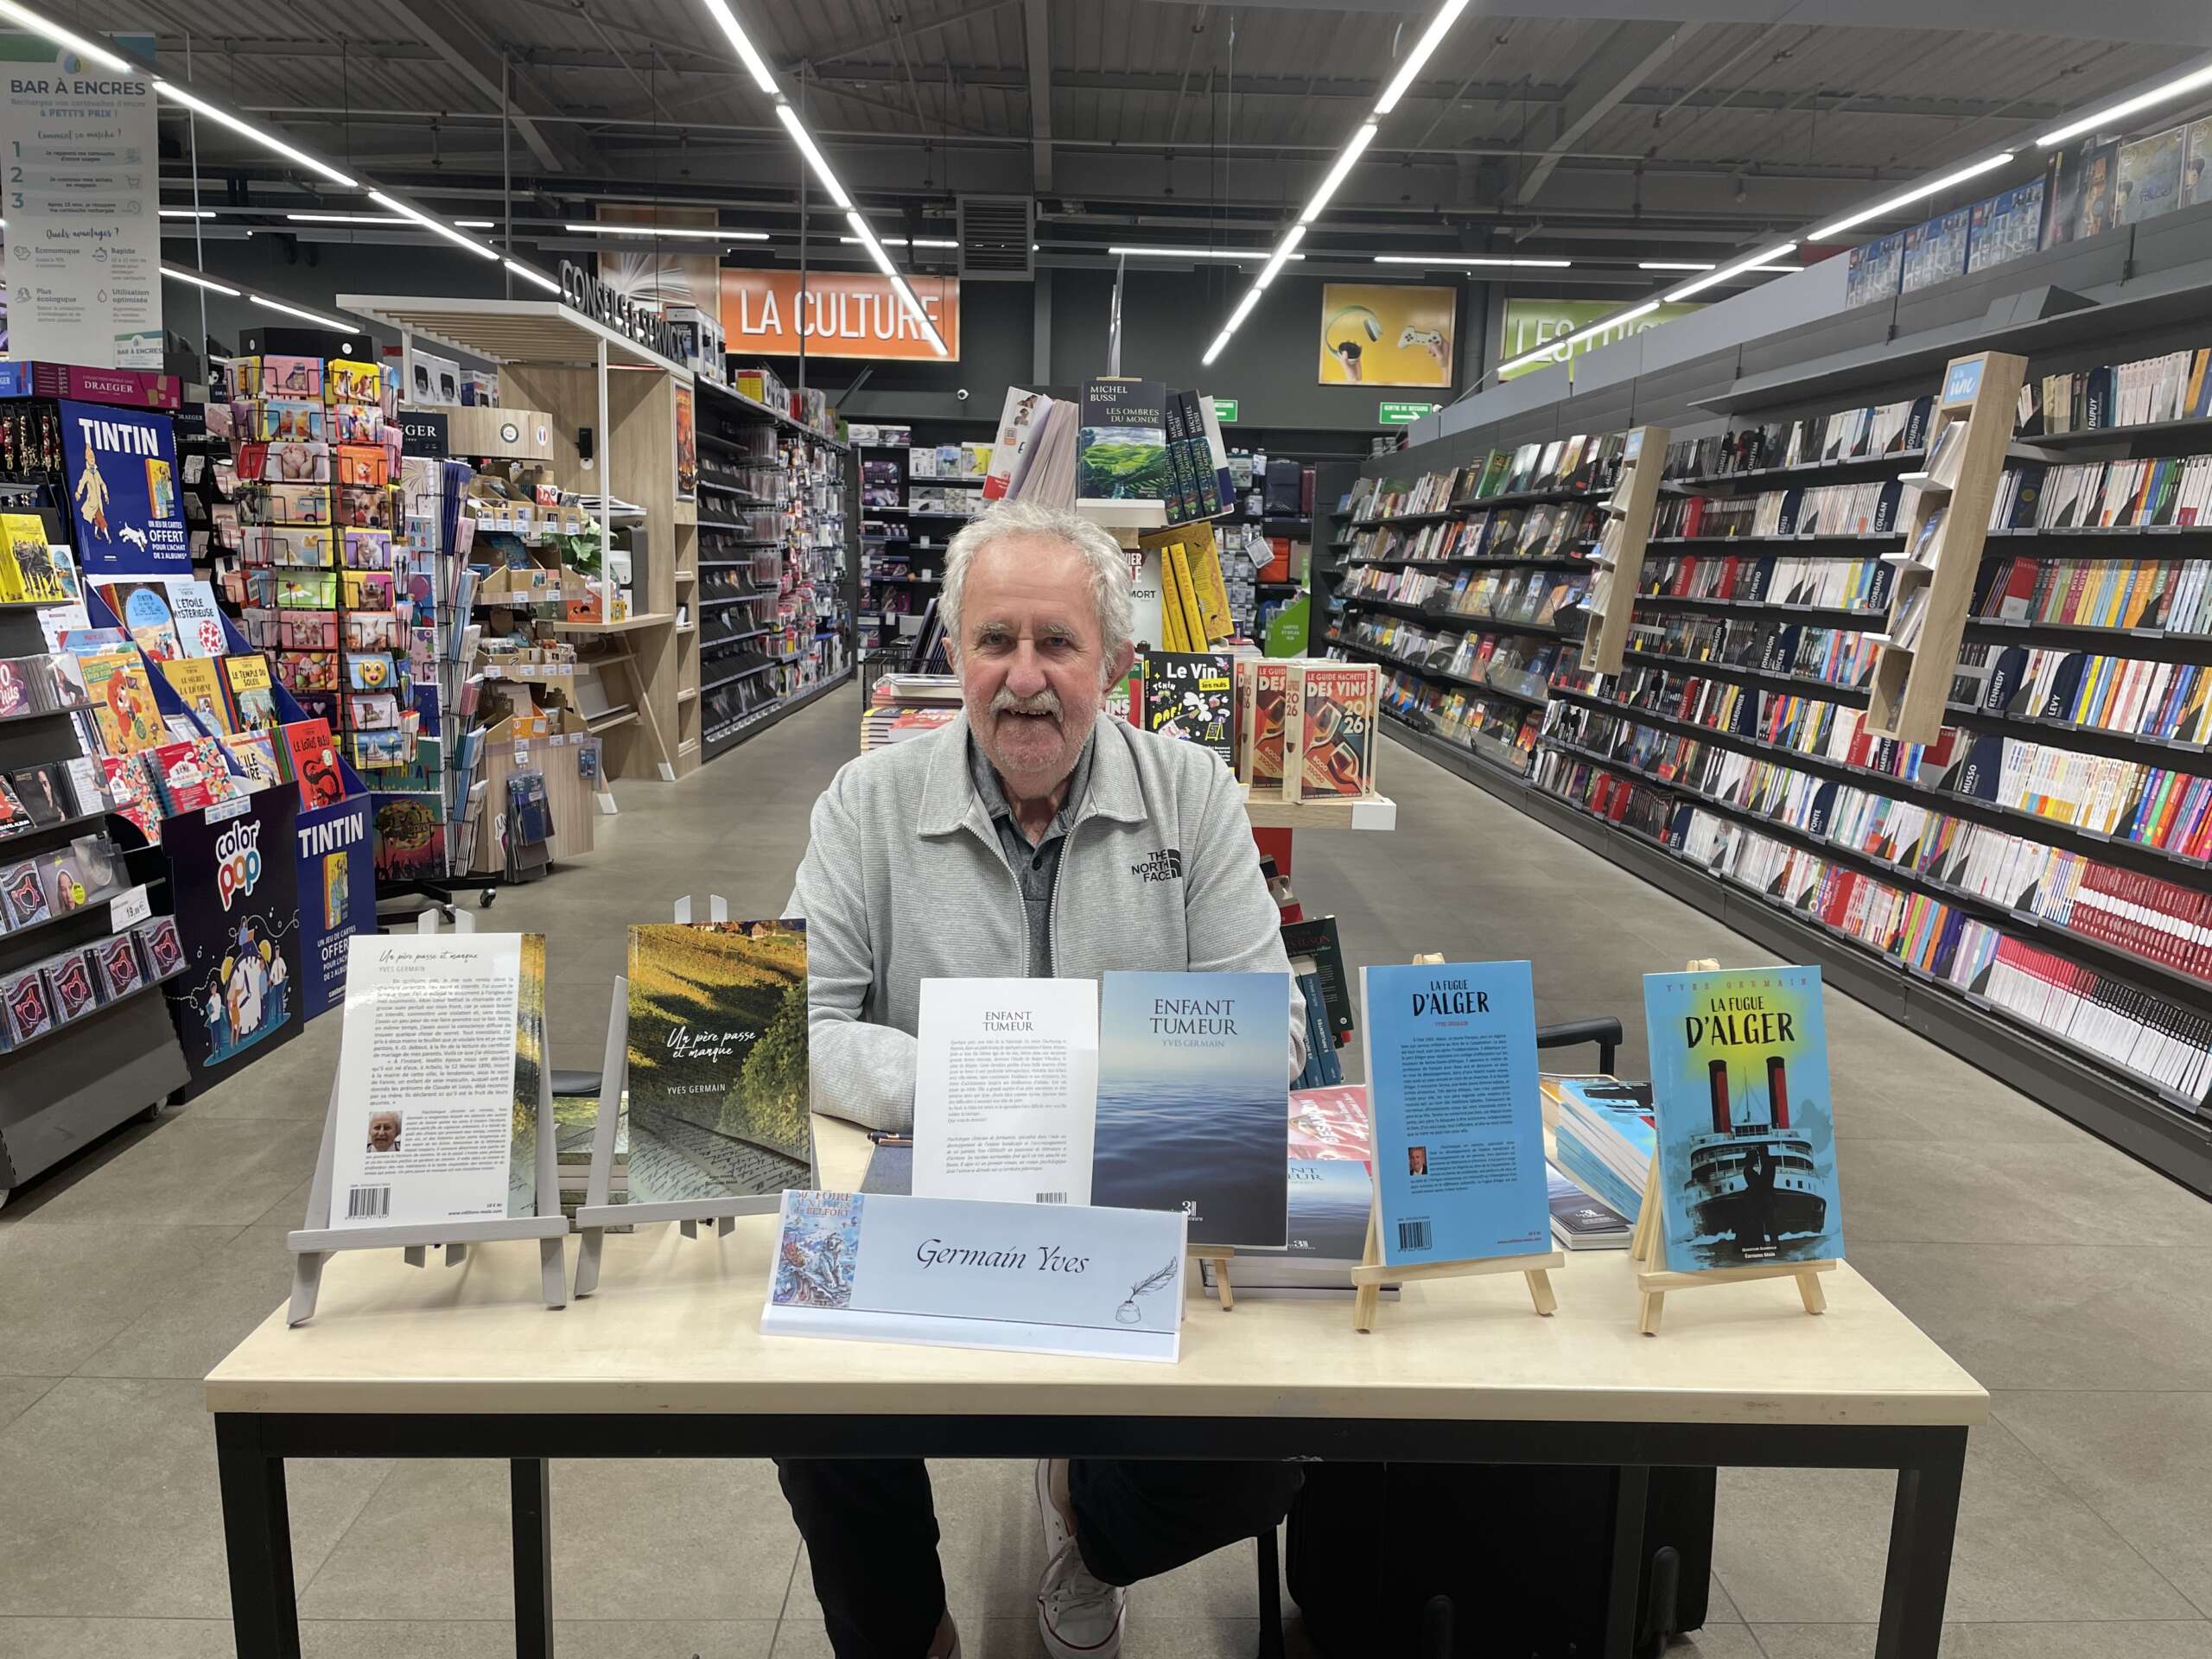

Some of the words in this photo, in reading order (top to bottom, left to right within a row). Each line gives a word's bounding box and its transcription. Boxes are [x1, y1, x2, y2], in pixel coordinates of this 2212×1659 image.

[10, 79, 49, 94] BAR
[54, 77, 68, 94] À
[73, 80, 146, 95] ENCRES
[49, 109, 85, 118] PETITS
[88, 109, 111, 118] PRIX
[12, 141, 21, 157] 1
[10, 167, 23, 182] 2
[11, 192, 24, 208] 3
[46, 228, 70, 238] Quels
[741, 289, 783, 335] LA
[84, 380, 134, 394] DRAEGER
[1090, 385, 1128, 394] MICHEL
[1090, 394, 1116, 403] BUSSI
[1106, 407, 1121, 416] LES
[1122, 408, 1160, 416] OMBRES
[2088, 397, 2098, 428] DUPUY
[1126, 416, 1160, 424] MONDE
[78, 417, 160, 457] TINTIN
[1875, 501, 1888, 531] COLGAN
[149, 529, 184, 543] OFFERT
[152, 543, 167, 551] POUR
[153, 551, 161, 560] DE
[1868, 569, 1885, 608] GIORDANO
[1761, 635, 1776, 669] JONASSON
[232, 671, 238, 679] LE
[239, 669, 258, 678] TEMPLE
[1166, 662, 1187, 679] Le
[1190, 663, 1218, 679] Vin
[1259, 667, 1267, 676] LE
[1338, 672, 1366, 681] HACHETTE
[243, 678, 260, 687] SOLEIL
[1258, 677, 1286, 691] DES
[1306, 682, 1332, 697] DES
[1336, 682, 1366, 696] VINS
[1986, 670, 2005, 709] KENNEDY
[1286, 692, 1300, 704] 20
[2047, 694, 2061, 717] LEVY
[1286, 704, 1299, 717] 26
[1344, 701, 1365, 715] 20
[1344, 717, 1364, 734] 26
[294, 741, 301, 753] LE
[302, 737, 317, 751] LOTUS
[317, 735, 330, 747] BLEU
[1878, 737, 1892, 772] MARTIN-LU
[1962, 764, 1977, 794] MUSSO
[217, 820, 261, 861] color
[298, 812, 364, 858] TINTIN
[1147, 850, 1167, 861] THE
[1132, 861, 1171, 875] NORTH
[219, 848, 261, 911] pop
[1143, 871, 1171, 882] FACE
[325, 935, 334, 945] JEU
[334, 932, 341, 941] DE
[340, 925, 357, 938] CARTES
[321, 939, 350, 962] OFFER
[323, 959, 337, 971] POUR
[323, 973, 330, 982] DE
[1430, 980, 1441, 991] LA
[1443, 979, 1469, 990] FUGUE
[1667, 983, 1710, 992] YVES
[1726, 977, 1808, 989] GERMAIN
[1154, 999, 1236, 1015] ENFANT
[1412, 991, 1491, 1017] D'ALGER
[1710, 998, 1727, 1012] LA
[1728, 996, 1764, 1011] FUGUE
[985, 1011, 1033, 1021] ENFANT
[982, 1022, 1034, 1032] TUMEUR
[1149, 1018, 1238, 1036] TUMEUR
[1685, 1013, 1796, 1049] D'ALGER
[666, 1026, 690, 1049] Un
[692, 1030, 720, 1047] père
[720, 1030, 757, 1045] passe
[1161, 1039, 1183, 1048] YVES
[1182, 1039, 1224, 1048] GERMAIN
[672, 1043, 692, 1058] et
[688, 1046, 734, 1064] manque
[666, 1085, 687, 1095] YVES
[689, 1083, 727, 1094] GERMAIN
[816, 1192, 852, 1201] FOIRE
[806, 1207, 850, 1217] BELFORT
[916, 1237, 1027, 1270] Germain
[1036, 1244, 1090, 1274] Yves
